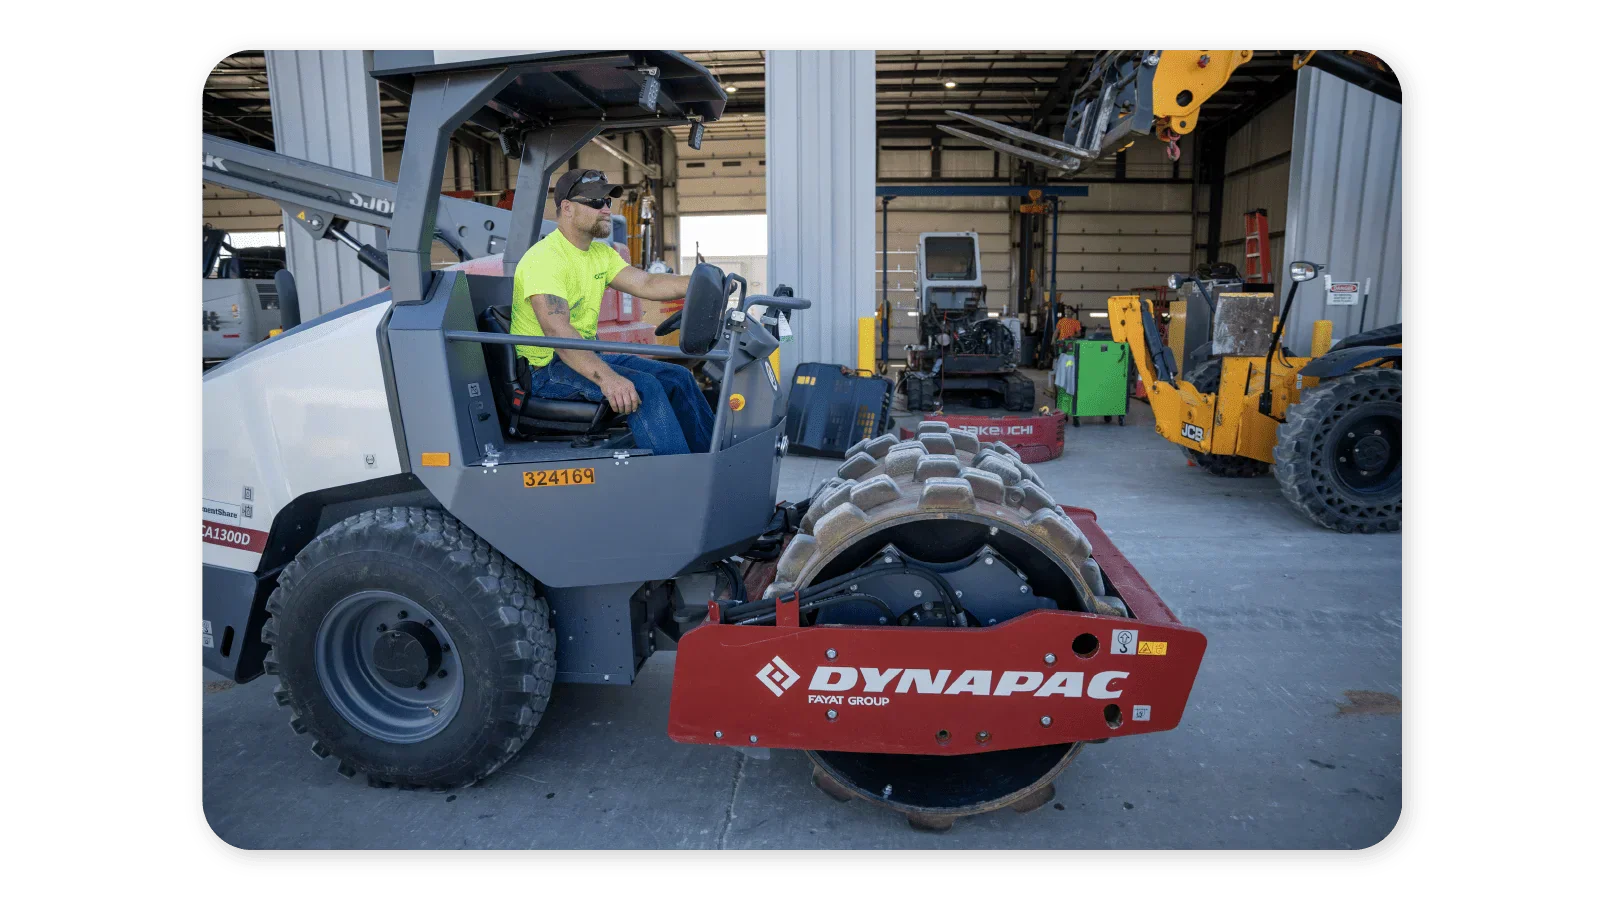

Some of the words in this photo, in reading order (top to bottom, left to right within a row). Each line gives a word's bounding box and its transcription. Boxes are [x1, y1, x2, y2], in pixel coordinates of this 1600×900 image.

[1181, 424, 1204, 442] JCB
[525, 468, 594, 486] 324169
[808, 666, 1130, 699] DYNAPAC
[808, 695, 845, 705] FAYAT
[847, 696, 890, 706] GROUP
